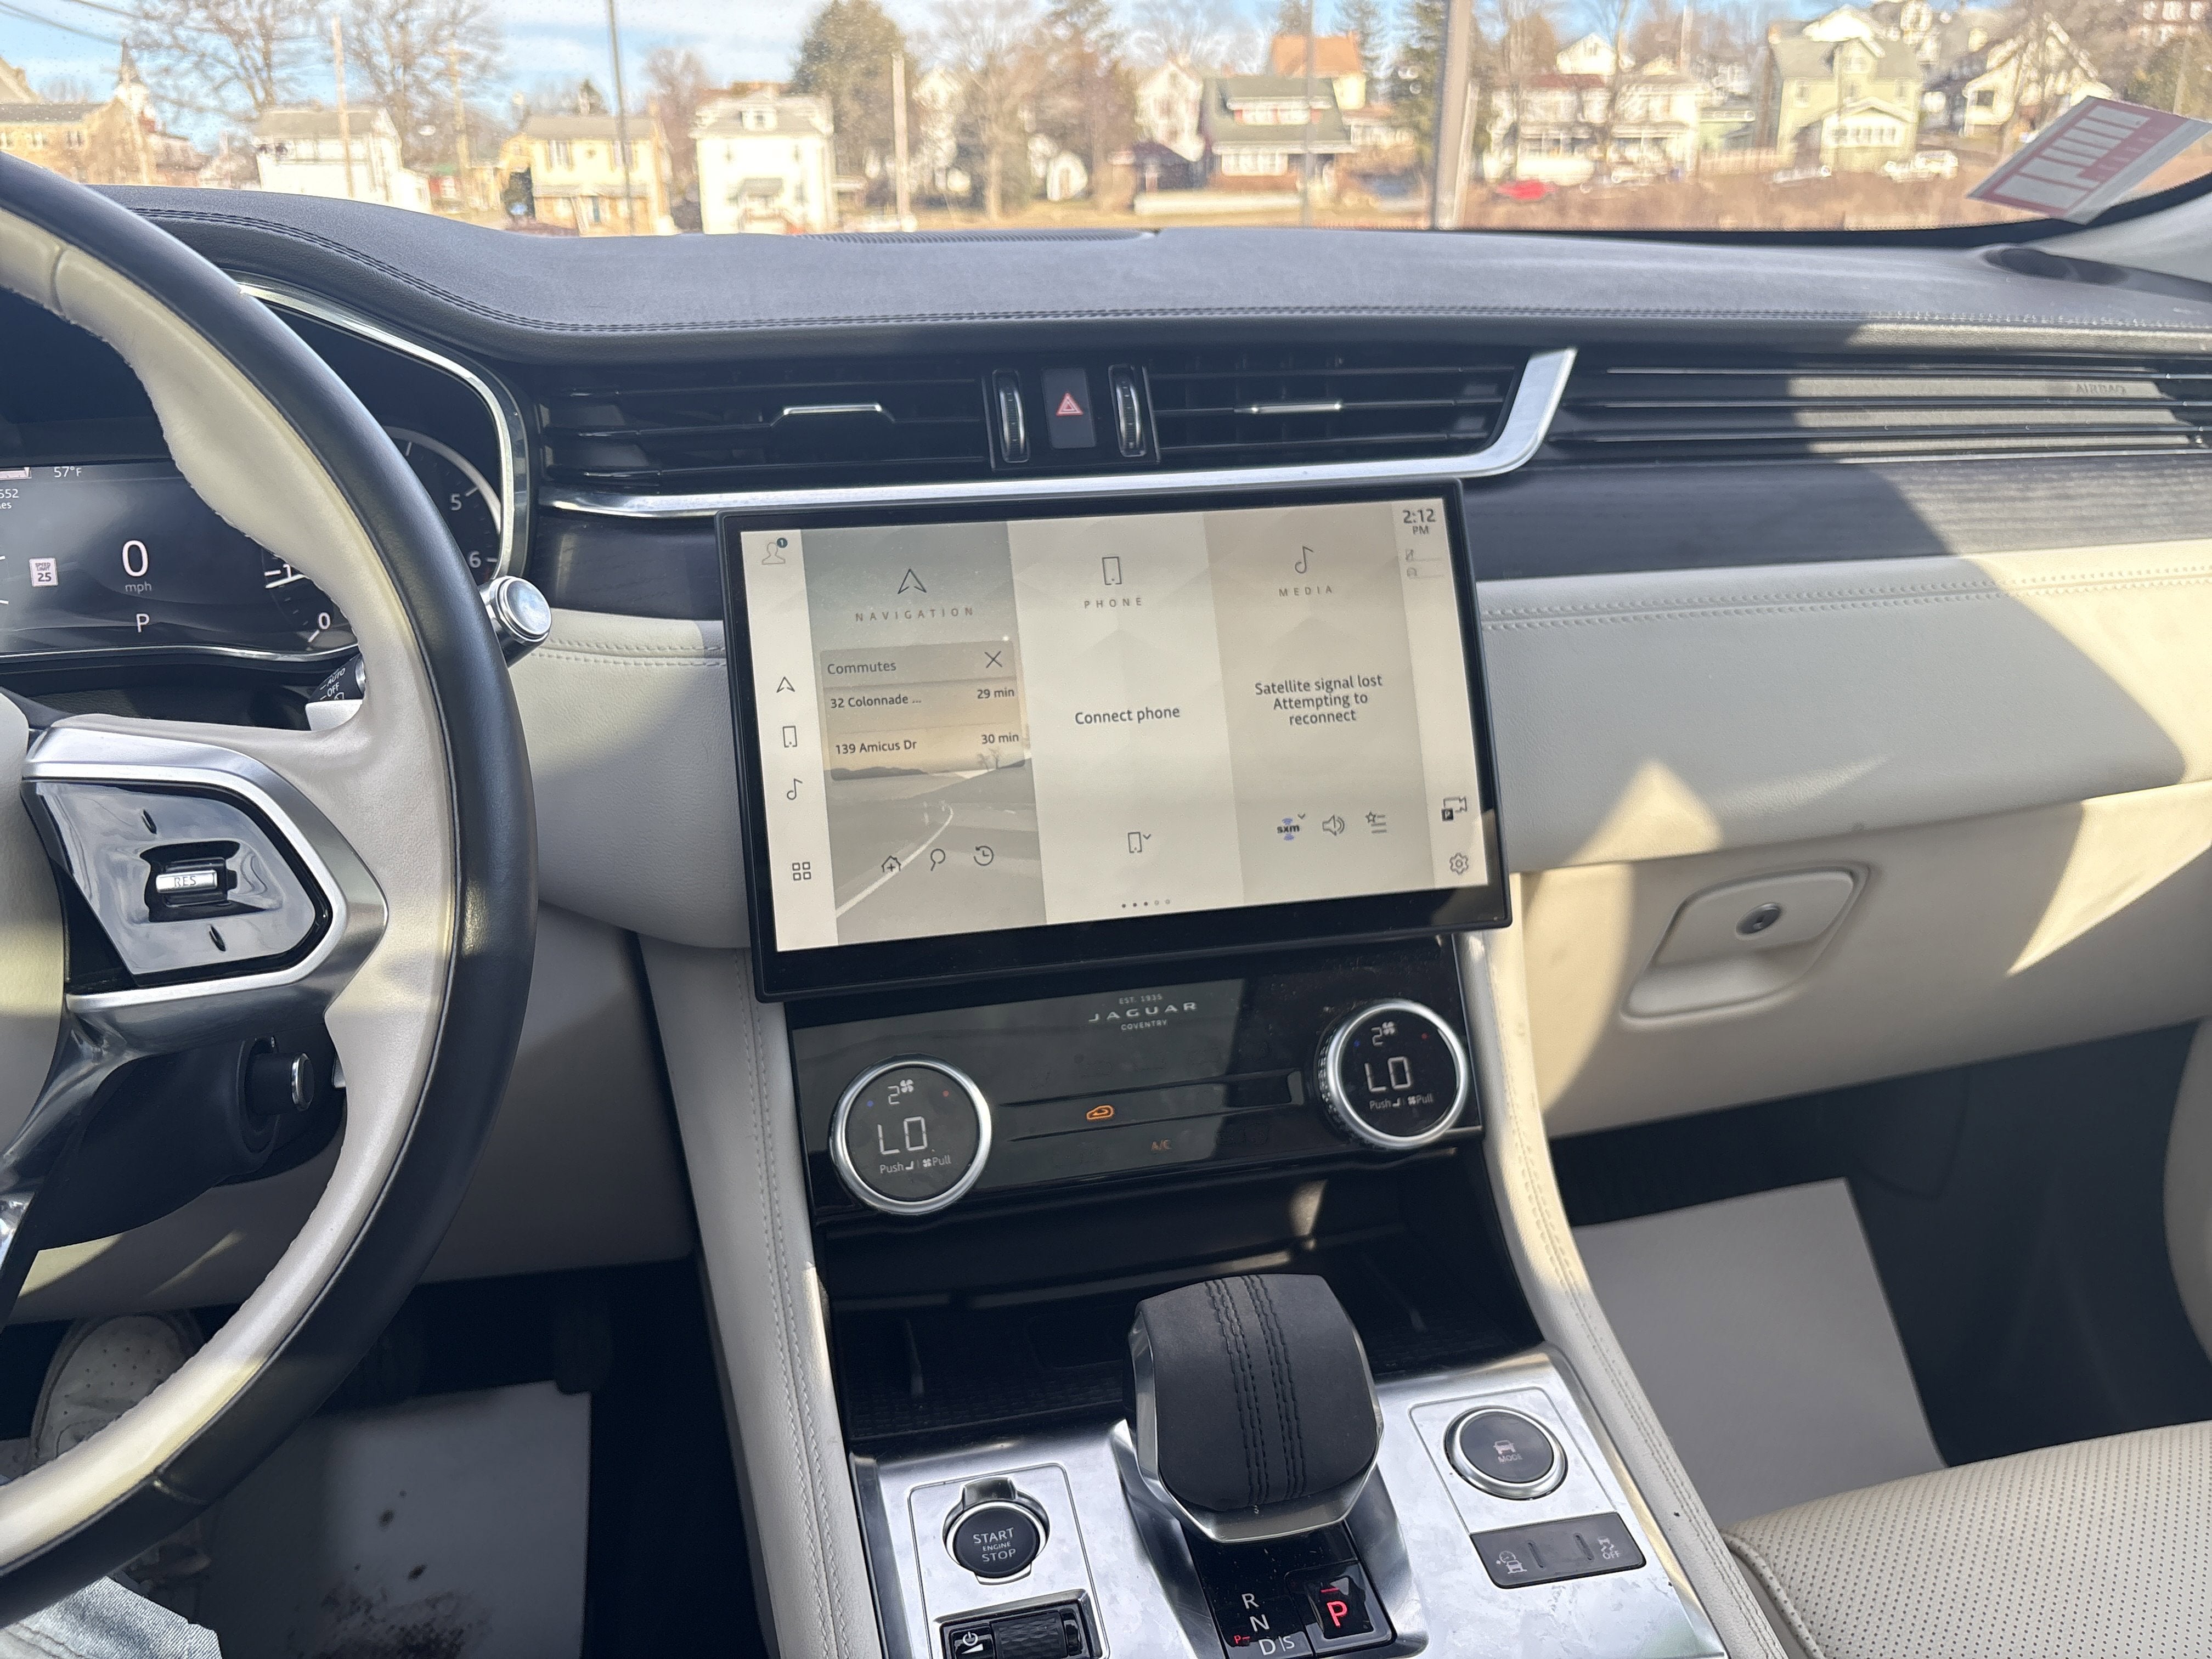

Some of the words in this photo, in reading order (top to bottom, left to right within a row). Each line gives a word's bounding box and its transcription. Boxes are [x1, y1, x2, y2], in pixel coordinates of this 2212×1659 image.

[450, 494, 462, 511] 5
[1403, 509, 1437, 523] 2:12
[1412, 525, 1429, 535] PM
[122, 540, 149, 577] 0
[469, 551, 482, 568] 6
[38, 572, 52, 582] 25
[125, 582, 152, 594] mph
[1278, 585, 1333, 597] MEDIA
[1084, 597, 1142, 609] PHONE
[318, 612, 331, 630] 0
[855, 607, 974, 622] NAVIGATION
[136, 613, 150, 633] P
[827, 661, 896, 675] Commutes
[326, 667, 346, 687] AUTO
[1255, 679, 1311, 695] Satellite
[1314, 675, 1354, 692] signal
[1358, 674, 1383, 688] lost
[327, 681, 340, 697] OFF
[977, 689, 990, 699] 29
[994, 687, 1015, 698] min
[830, 698, 844, 708] 32
[848, 693, 909, 708] Colonnade
[1273, 693, 1351, 710] Attempting
[1354, 692, 1368, 705] to
[1075, 709, 1132, 724] Connect
[1137, 707, 1181, 724] phone
[1289, 709, 1356, 725] reconnect
[836, 743, 856, 754] 139
[859, 740, 900, 753] Amicus
[904, 738, 917, 751] Dr
[981, 733, 995, 744] 30
[997, 732, 1019, 743] min
[173, 875, 197, 887] RES
[1088, 1002, 1197, 1022] JAGUAR
[1121, 1019, 1167, 1031] COVENTRY
[1372, 1026, 1383, 1046] 2
[888, 1085, 900, 1105] 2
[1369, 1098, 1391, 1110] Push
[1416, 1093, 1433, 1104] Pull
[879, 1162, 904, 1173] Push
[932, 1154, 951, 1166] Pull
[1498, 1454, 1523, 1463] MODE
[973, 1527, 1014, 1544] START
[982, 1541, 1012, 1551] ENGINE
[981, 1548, 1017, 1562] STOP
[1241, 1593, 1259, 1610] R
[1326, 1600, 1348, 1628] P
[1249, 1614, 1270, 1632] N
